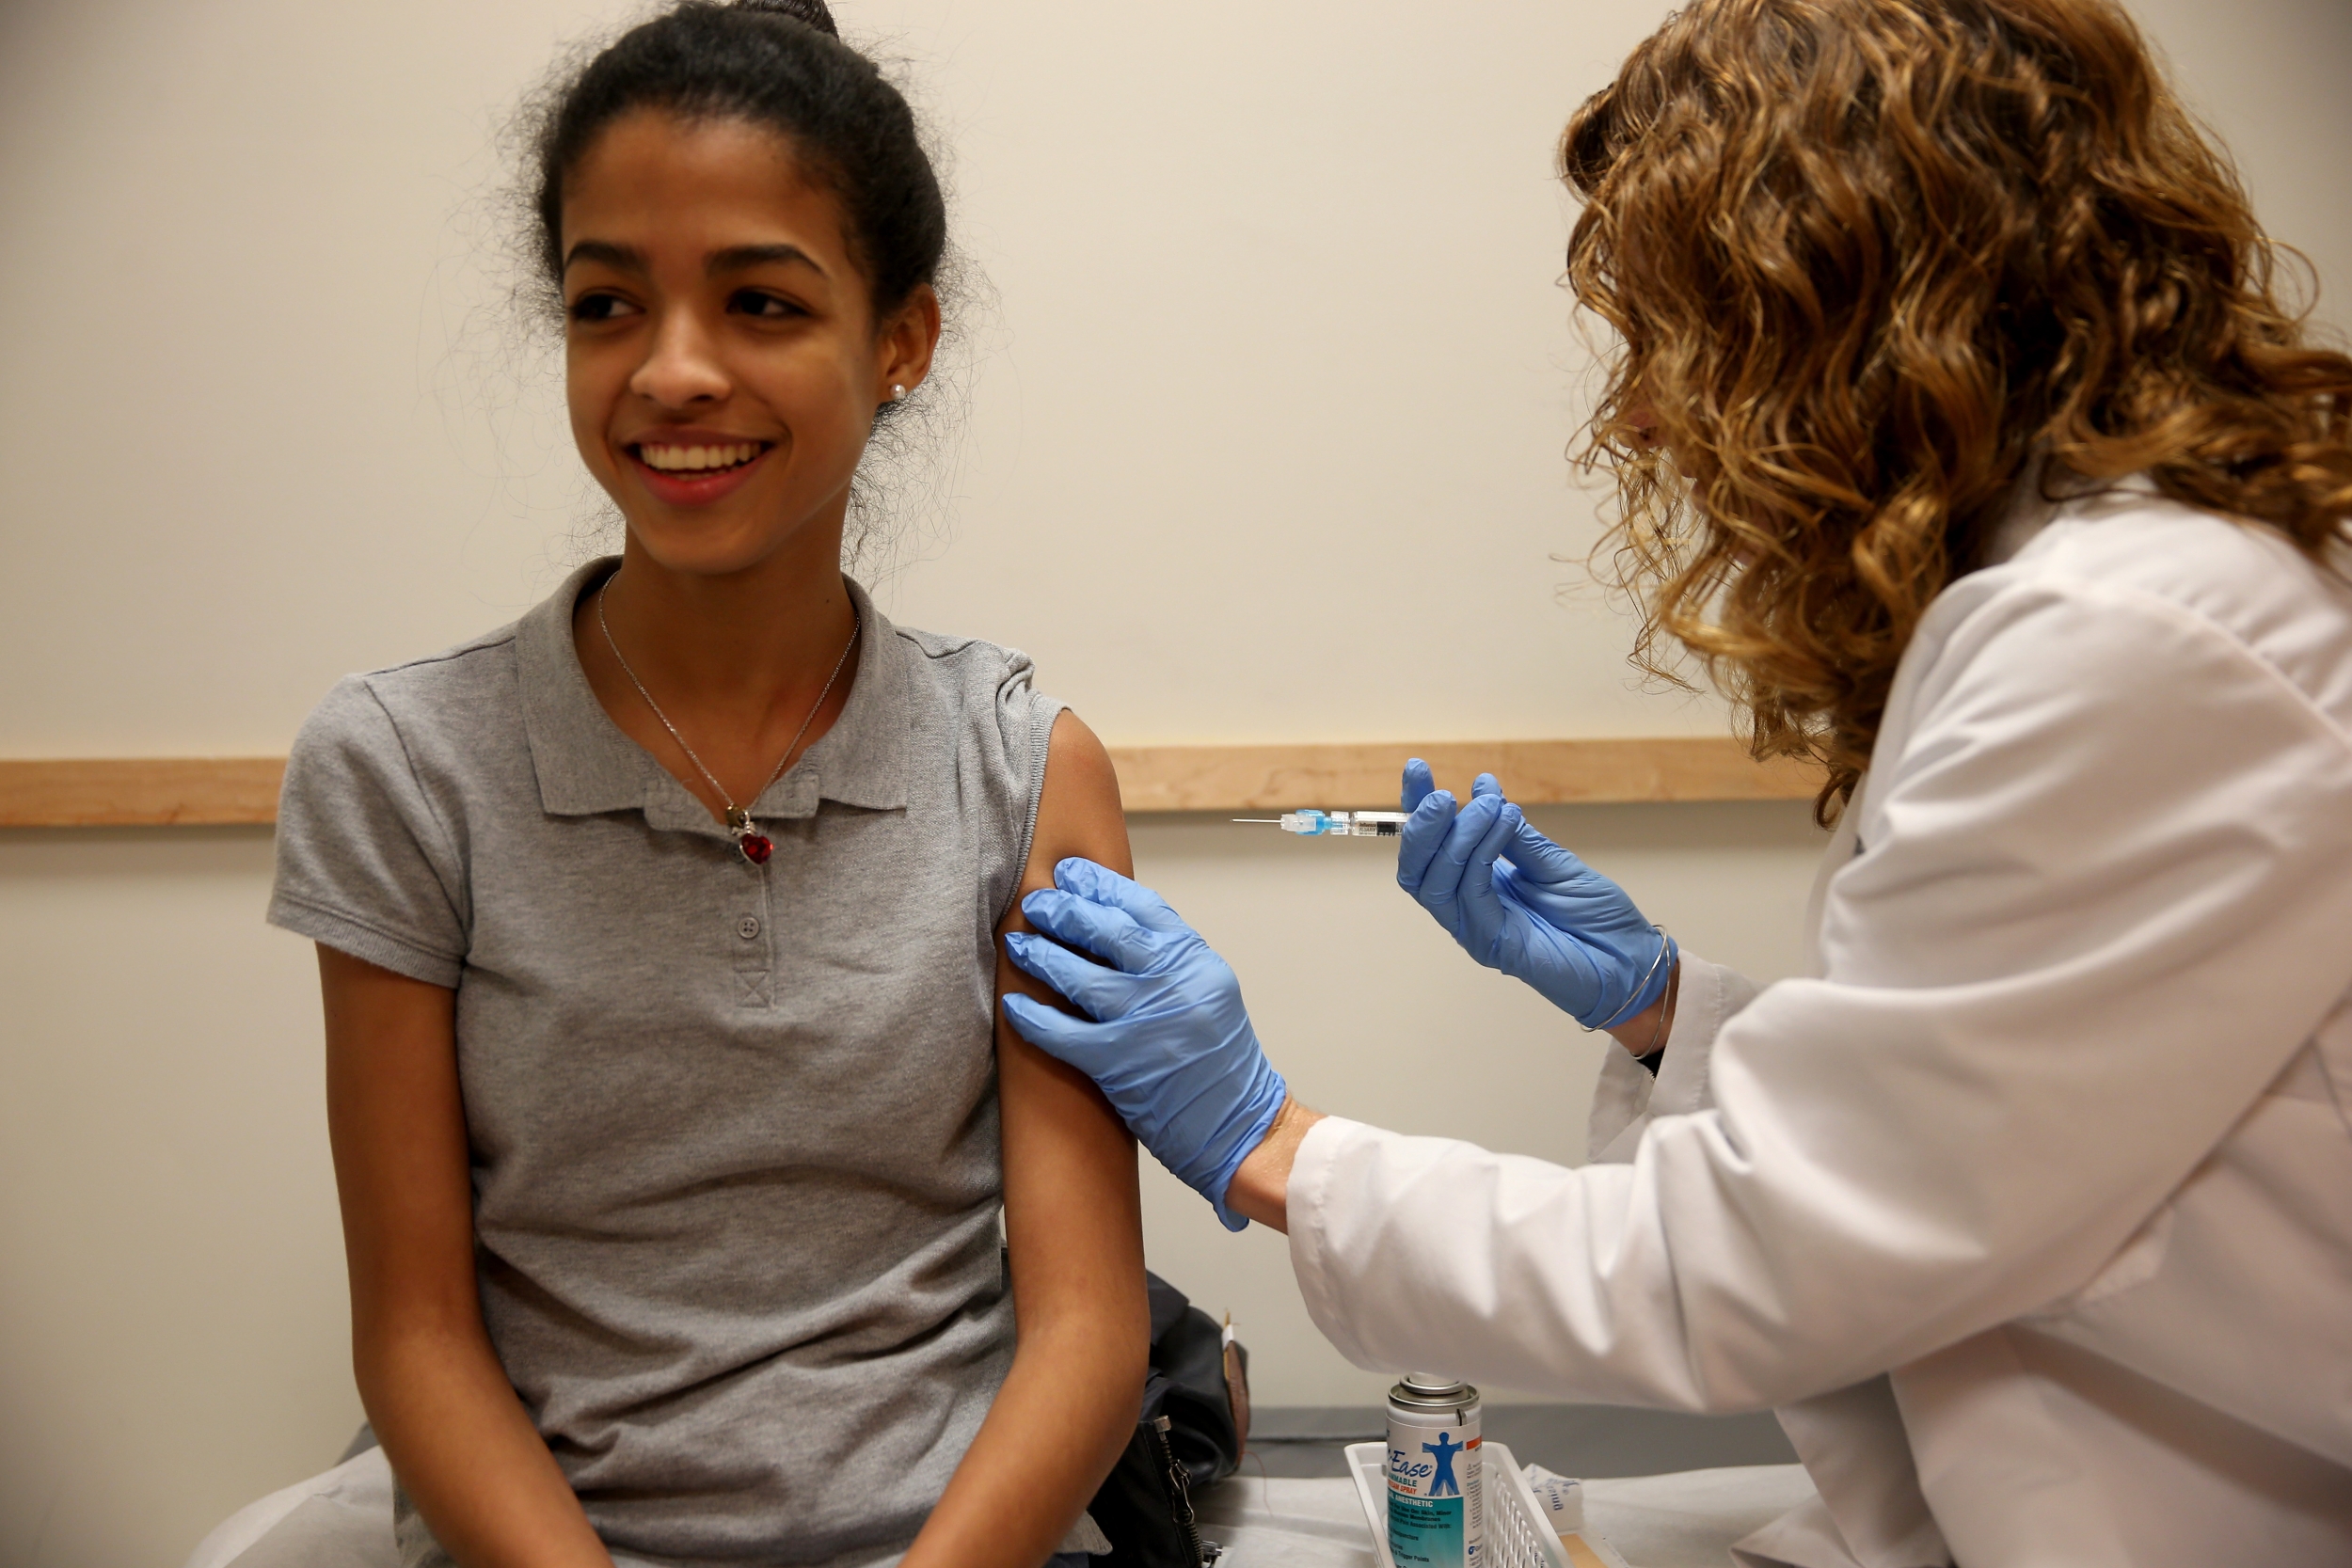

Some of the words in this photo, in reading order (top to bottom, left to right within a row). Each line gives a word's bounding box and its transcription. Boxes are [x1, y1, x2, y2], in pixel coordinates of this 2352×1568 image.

[1391, 1450, 1432, 1478] Ease
[1400, 1485, 1417, 1495] SPRAY
[1395, 1494, 1433, 1508] ANESTHETIC
